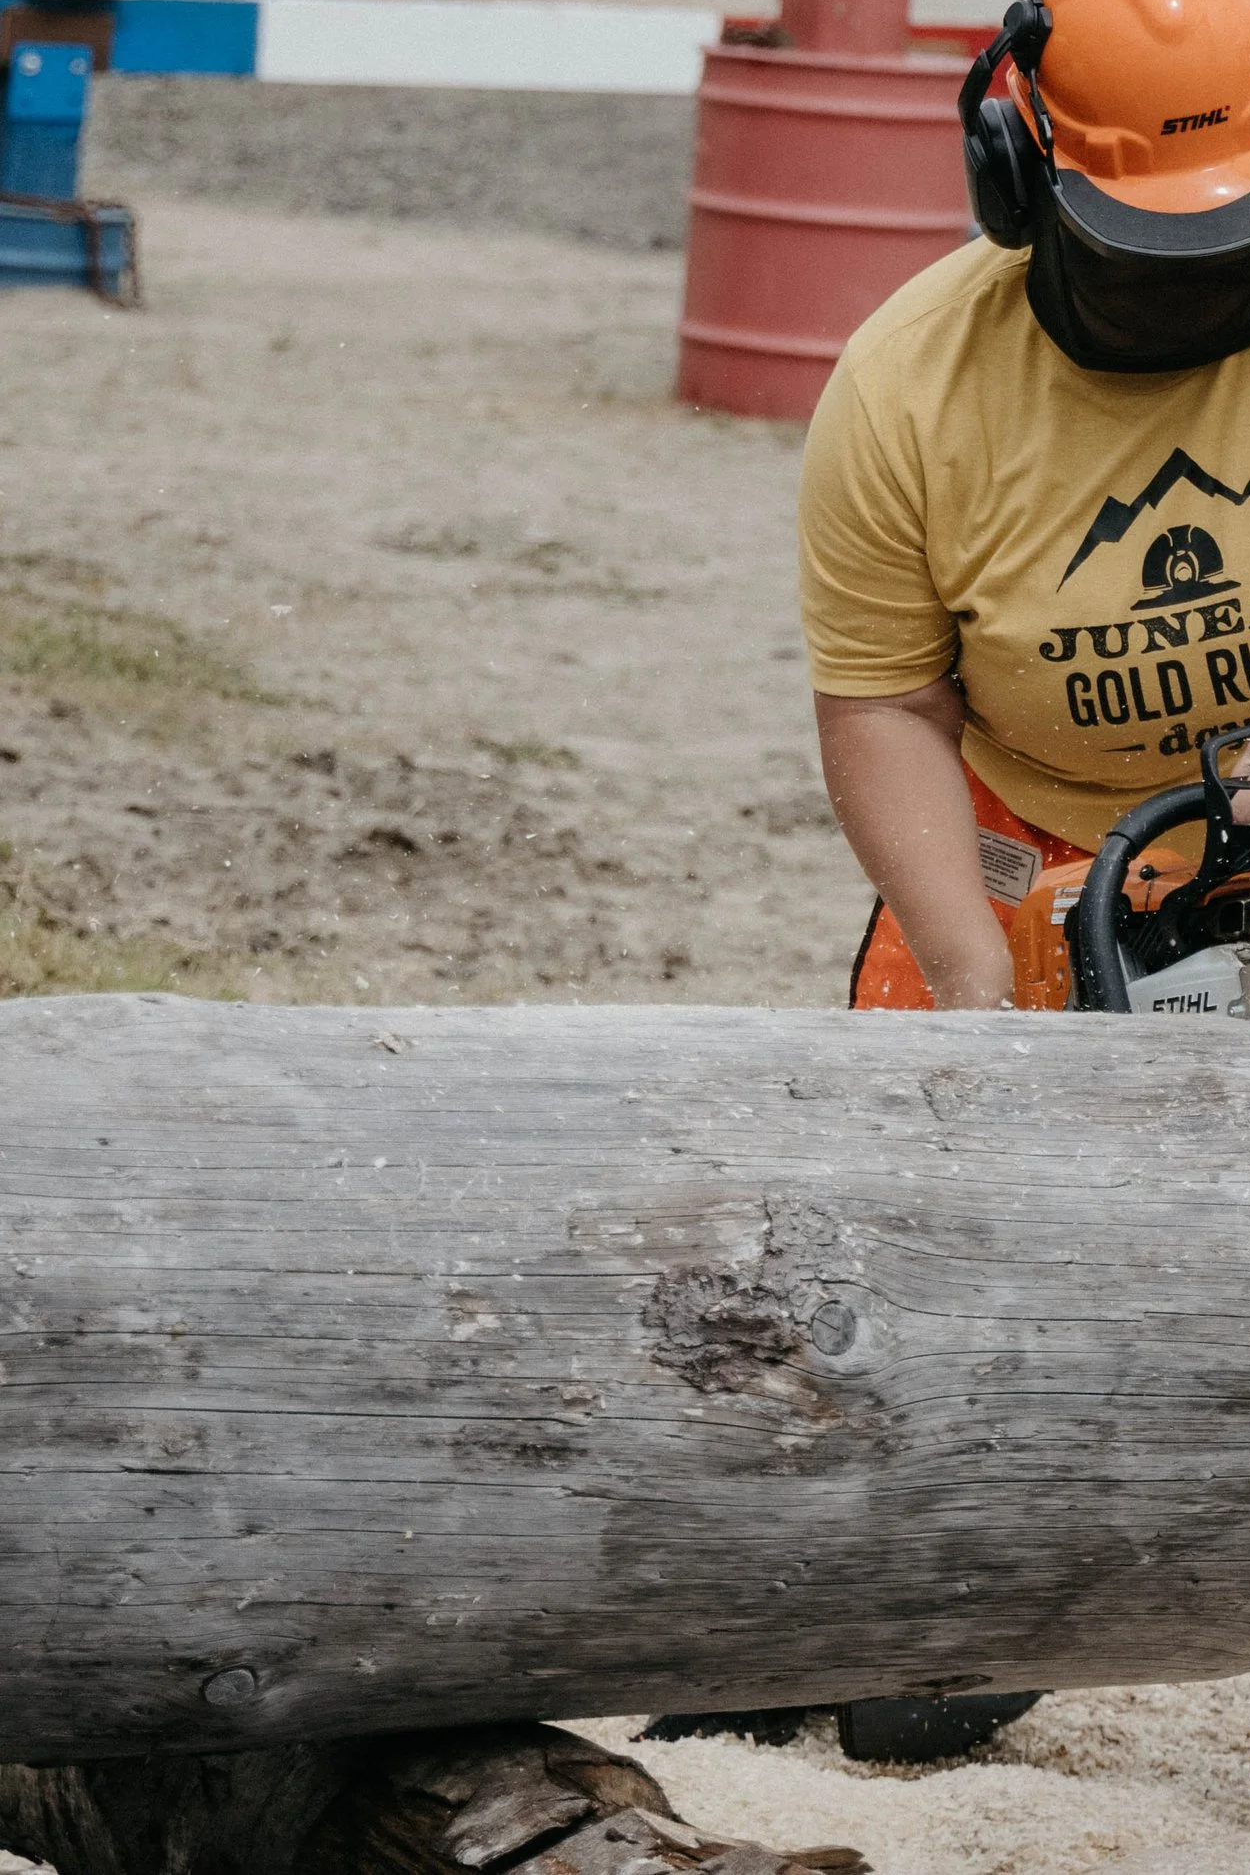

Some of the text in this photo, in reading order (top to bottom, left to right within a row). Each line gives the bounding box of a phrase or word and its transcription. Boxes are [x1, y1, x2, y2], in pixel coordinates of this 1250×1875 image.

[1160, 108, 1229, 135] STIHL
[1065, 659, 1194, 726] GOLD
[1153, 991, 1218, 1014] STIHL
